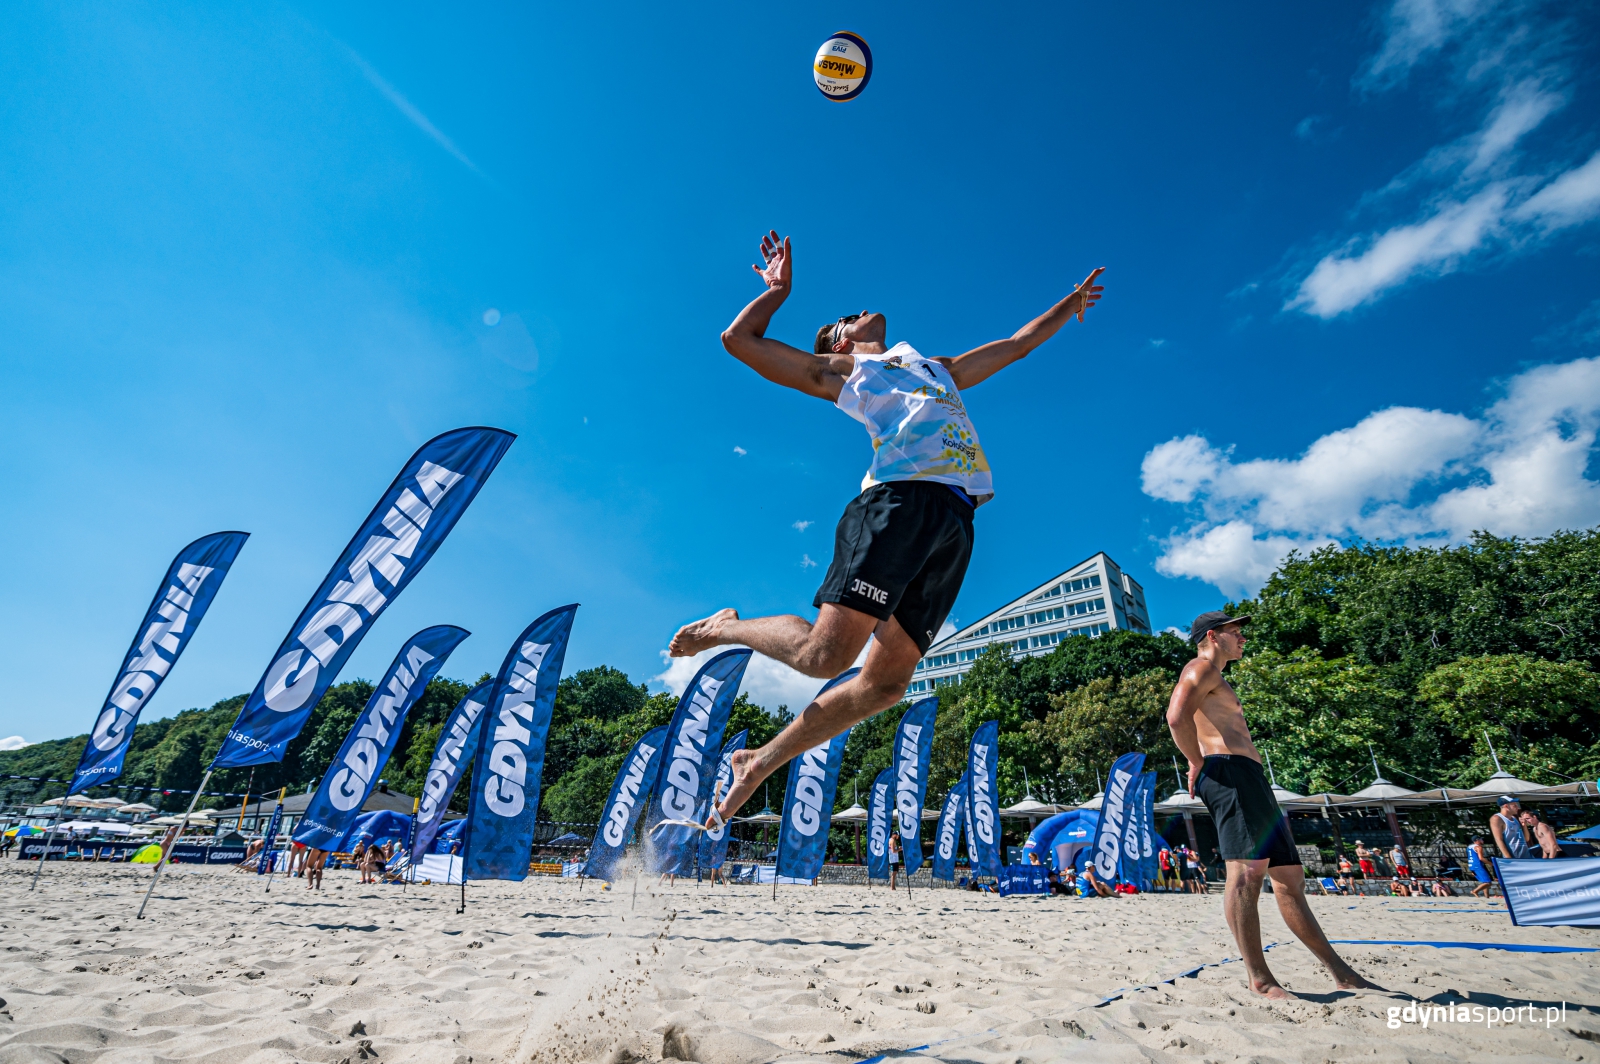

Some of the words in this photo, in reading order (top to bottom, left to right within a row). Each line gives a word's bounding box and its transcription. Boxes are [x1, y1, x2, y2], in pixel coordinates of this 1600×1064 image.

[921, 363, 938, 378] 1
[263, 460, 465, 713] GDYNIA
[851, 578, 889, 605] JETKE
[93, 562, 214, 751] GDYNIA
[329, 645, 435, 811] GDYNIA
[417, 699, 485, 824] GDYNIA
[484, 640, 551, 817] GDYNIA
[661, 673, 726, 822] GDYNIA
[897, 723, 923, 840] GDYNIA
[603, 742, 657, 848] GDYNIA
[869, 783, 889, 857] GDYNIA
[939, 793, 961, 860] GDYNIA
[973, 743, 994, 845] GDYNIA
[1094, 769, 1133, 880] GDYNIA
[210, 851, 244, 860] GDYNIA
